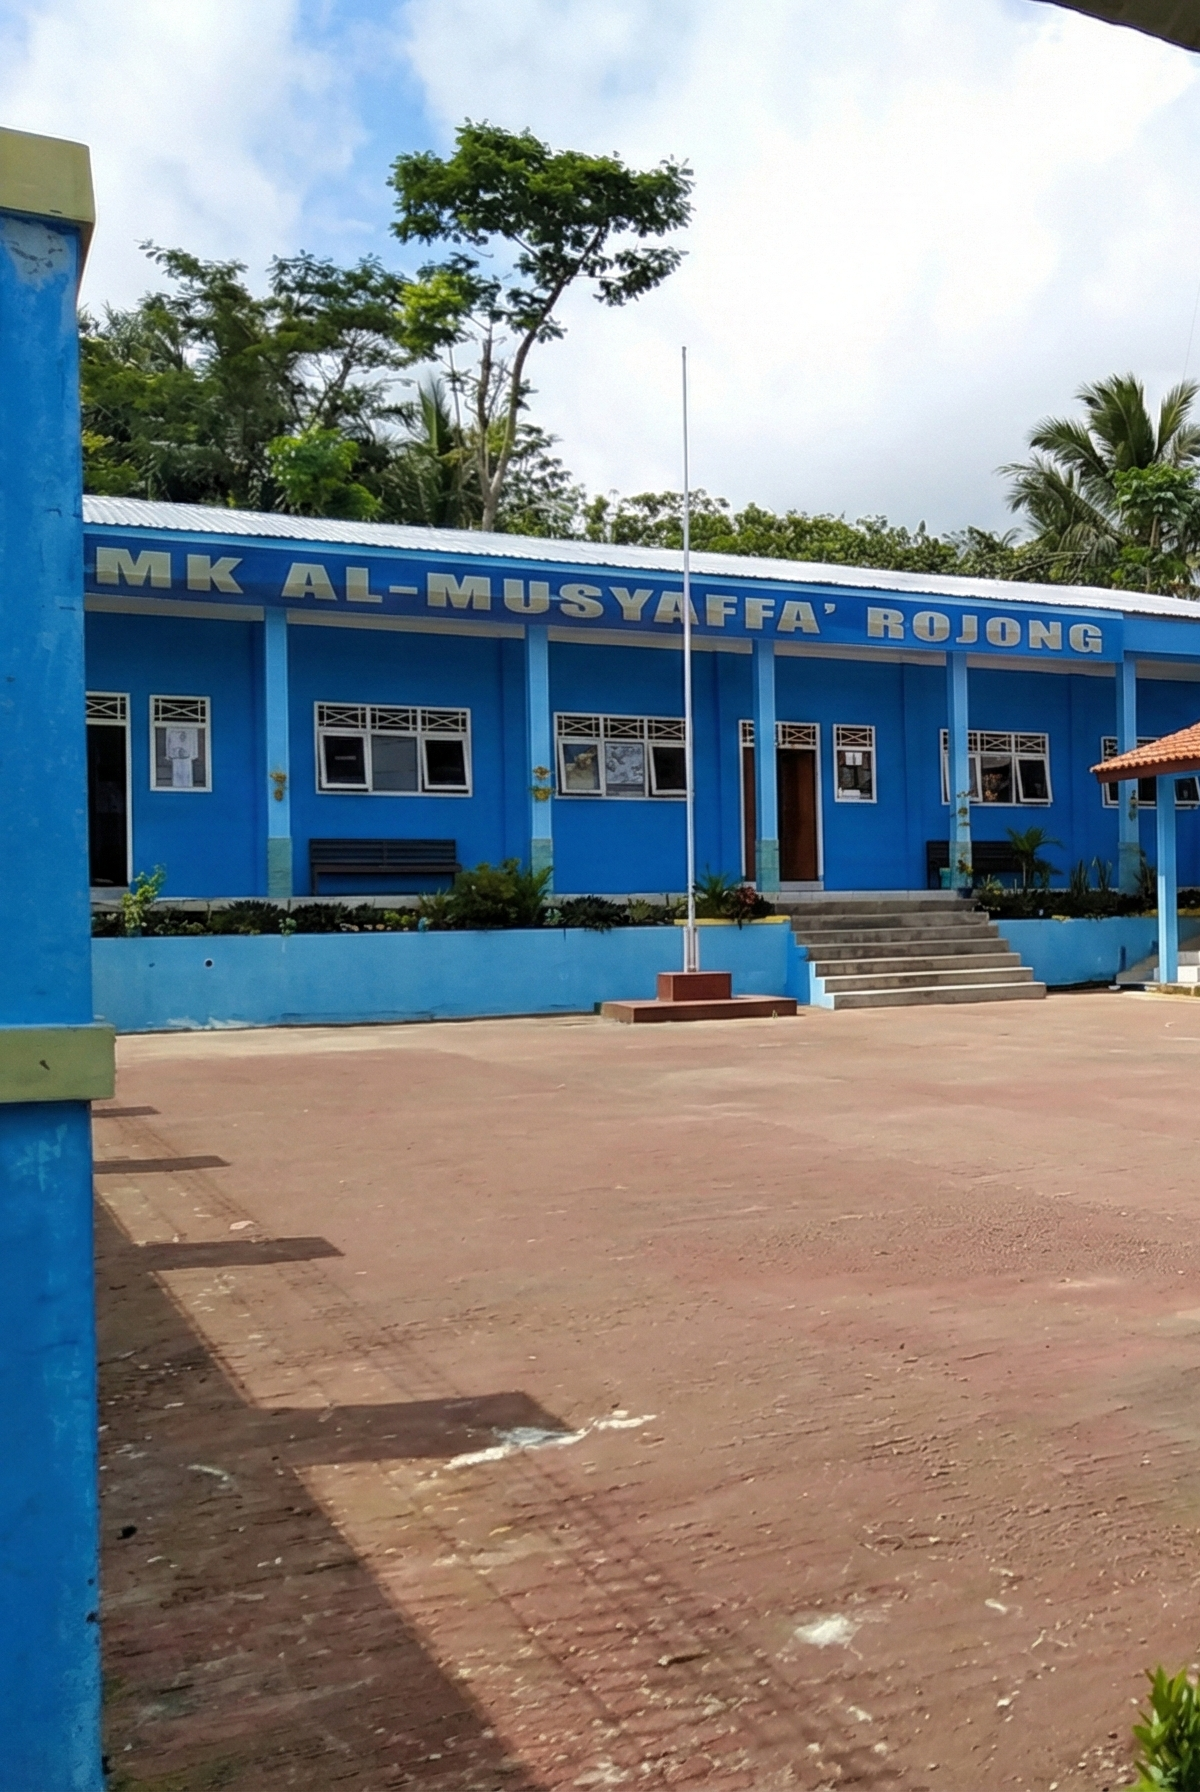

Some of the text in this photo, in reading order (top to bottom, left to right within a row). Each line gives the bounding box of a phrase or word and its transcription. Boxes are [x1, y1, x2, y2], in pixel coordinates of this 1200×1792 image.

[96, 546, 1103, 655] MK AL-MUSYAFFA' ROJONG
